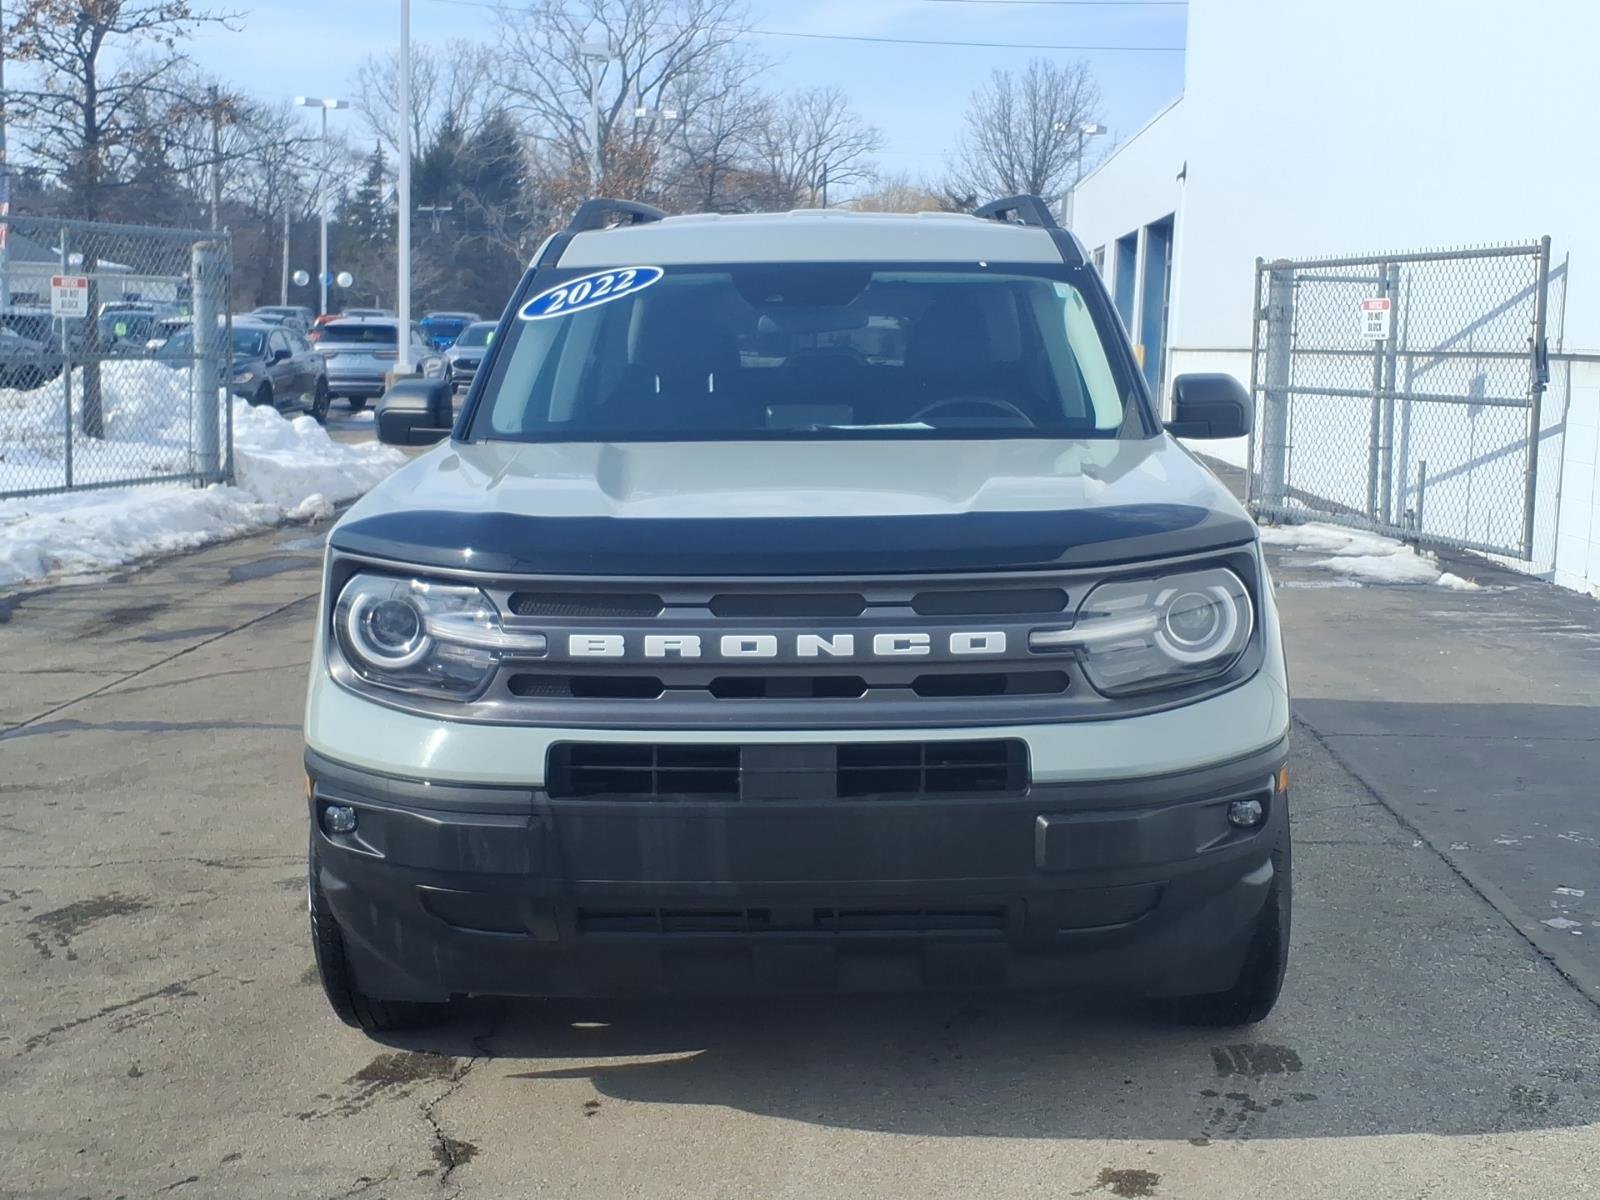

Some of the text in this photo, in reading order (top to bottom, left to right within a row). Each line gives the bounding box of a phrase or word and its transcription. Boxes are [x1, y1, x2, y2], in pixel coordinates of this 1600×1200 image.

[543, 269, 637, 314] 2022
[1368, 323, 1381, 331] BLOCK
[569, 631, 1007, 657] BRONCO
